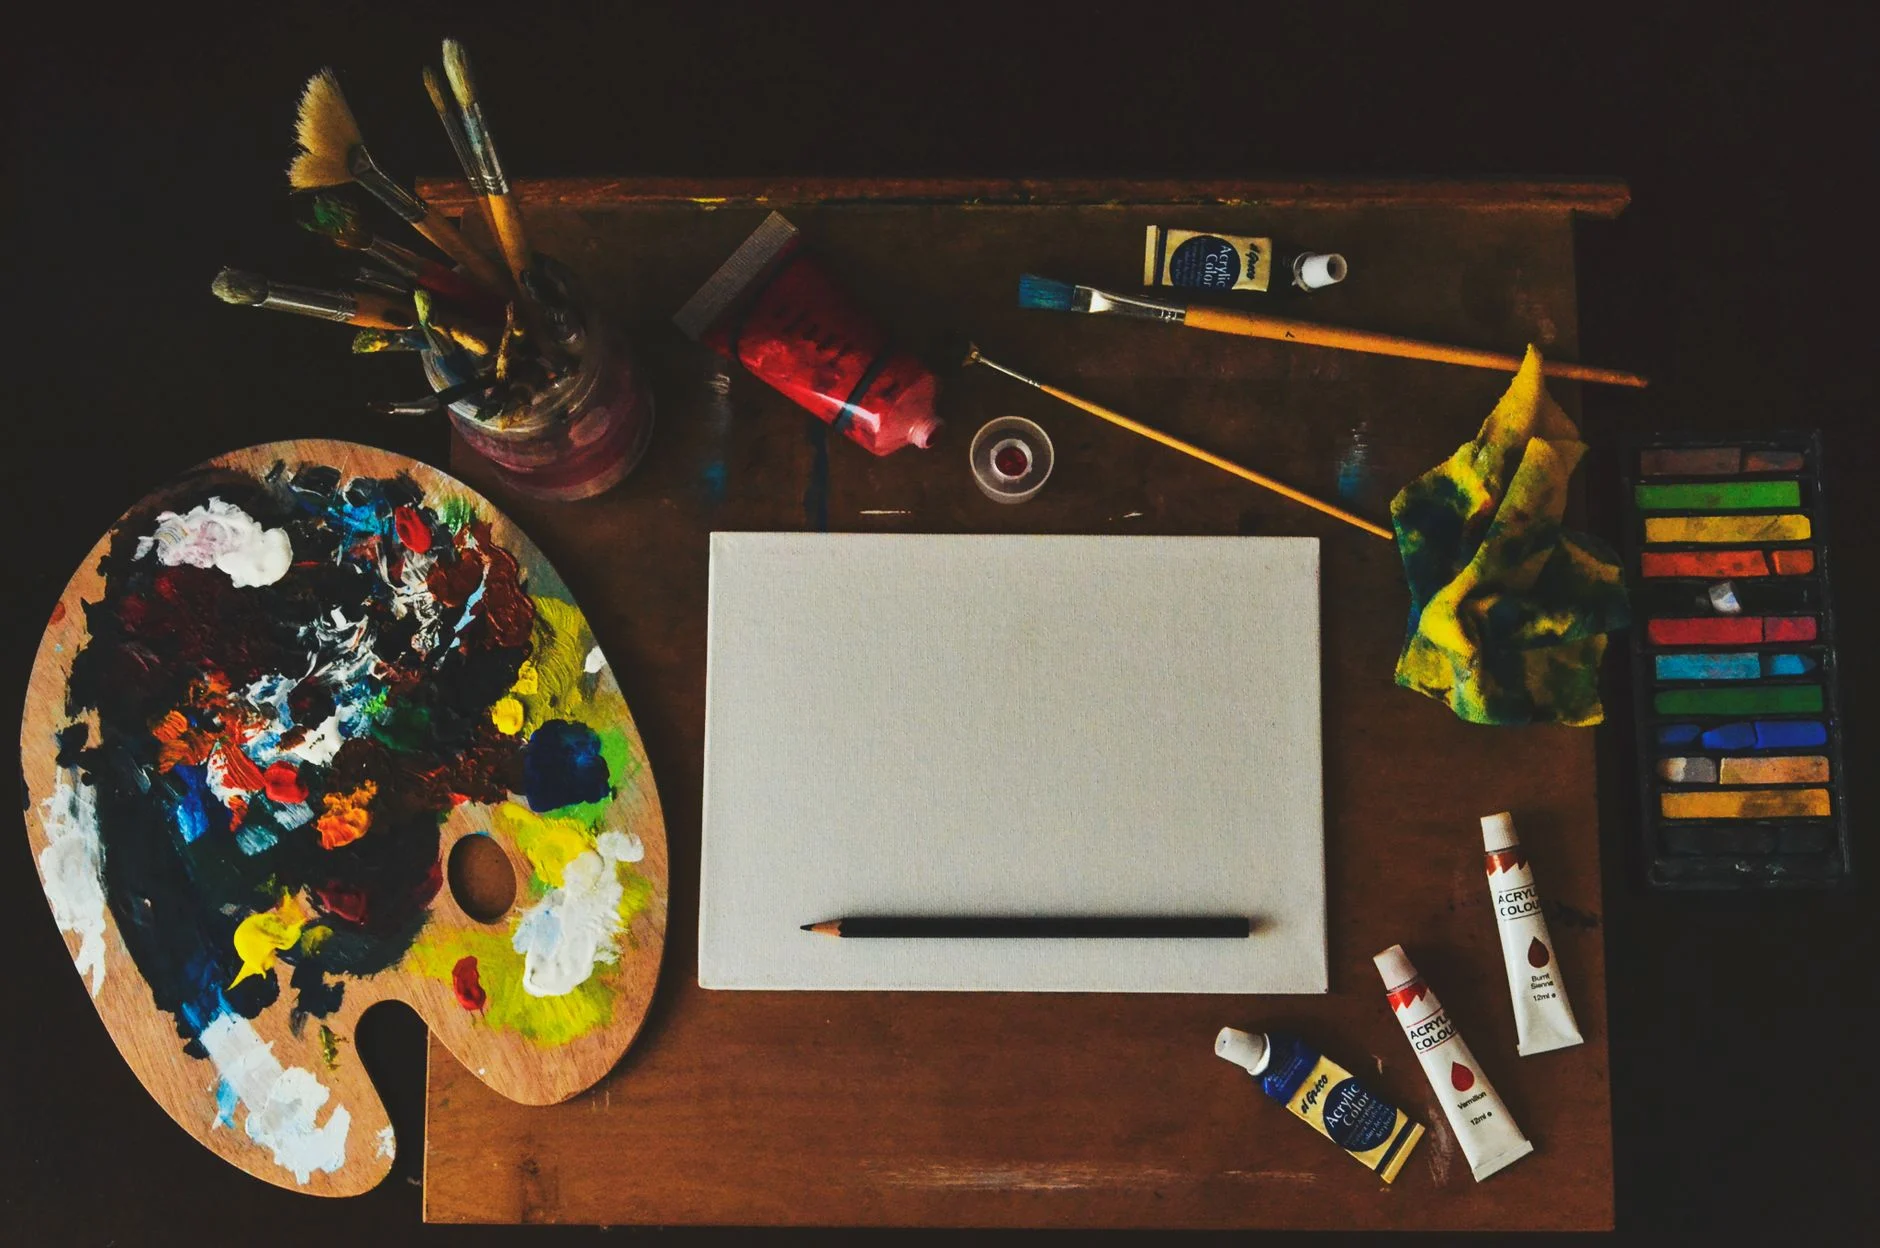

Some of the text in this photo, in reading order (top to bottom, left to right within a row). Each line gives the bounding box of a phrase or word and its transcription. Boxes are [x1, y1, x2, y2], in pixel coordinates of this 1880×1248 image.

[1202, 253, 1217, 288] Color
[1216, 245, 1233, 288] Acrylic
[1498, 887, 1536, 904] ACRYL
[1500, 900, 1540, 916] COLOU
[1530, 980, 1553, 989] Sienna
[1531, 973, 1550, 982] Burnt
[1415, 1024, 1455, 1051] COLOU
[1325, 1083, 1360, 1128] Acrylic
[1342, 1092, 1370, 1127] Color
